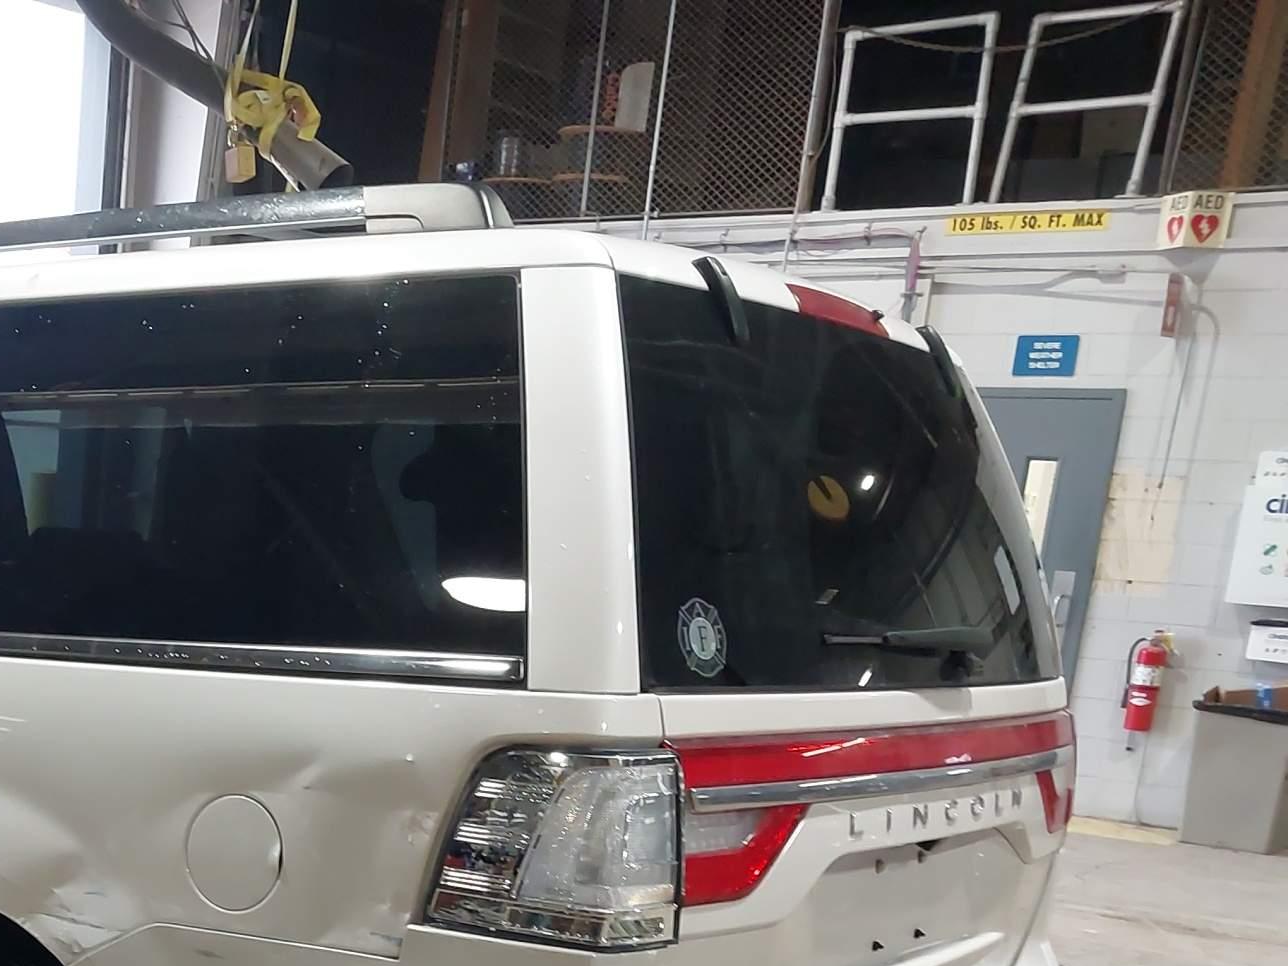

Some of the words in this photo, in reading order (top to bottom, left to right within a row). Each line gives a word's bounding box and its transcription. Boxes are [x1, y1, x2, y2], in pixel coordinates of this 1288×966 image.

[1170, 195, 1188, 210] AED
[1193, 194, 1225, 209] AED
[952, 217, 976, 232] 105
[980, 215, 1004, 231] lbs.
[1020, 215, 1041, 230] SQ.
[1048, 214, 1067, 229] FT.
[1072, 212, 1105, 228] MAX
[1265, 493, 1288, 514] ci
[849, 787, 1023, 841] LINCOLN
